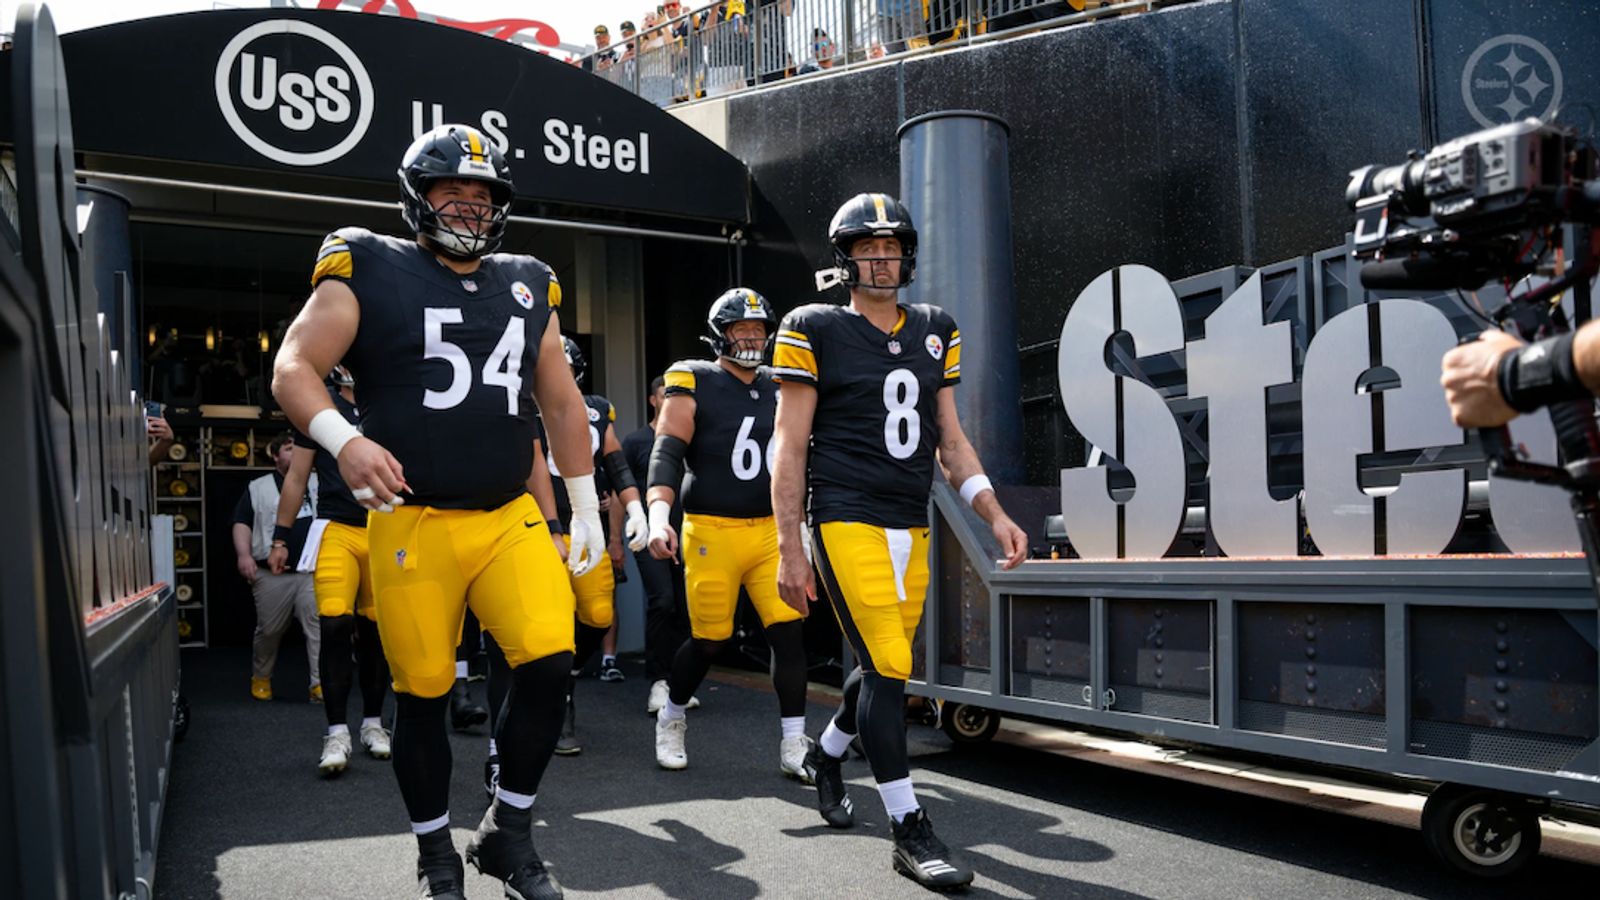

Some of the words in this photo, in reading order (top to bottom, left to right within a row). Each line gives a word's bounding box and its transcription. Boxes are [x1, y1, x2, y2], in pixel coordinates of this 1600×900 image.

[240, 52, 351, 131] USS
[411, 100, 443, 142] U
[543, 118, 649, 174] Steel
[422, 307, 526, 416] 54
[731, 416, 775, 480] 6
[883, 368, 920, 459] 8
